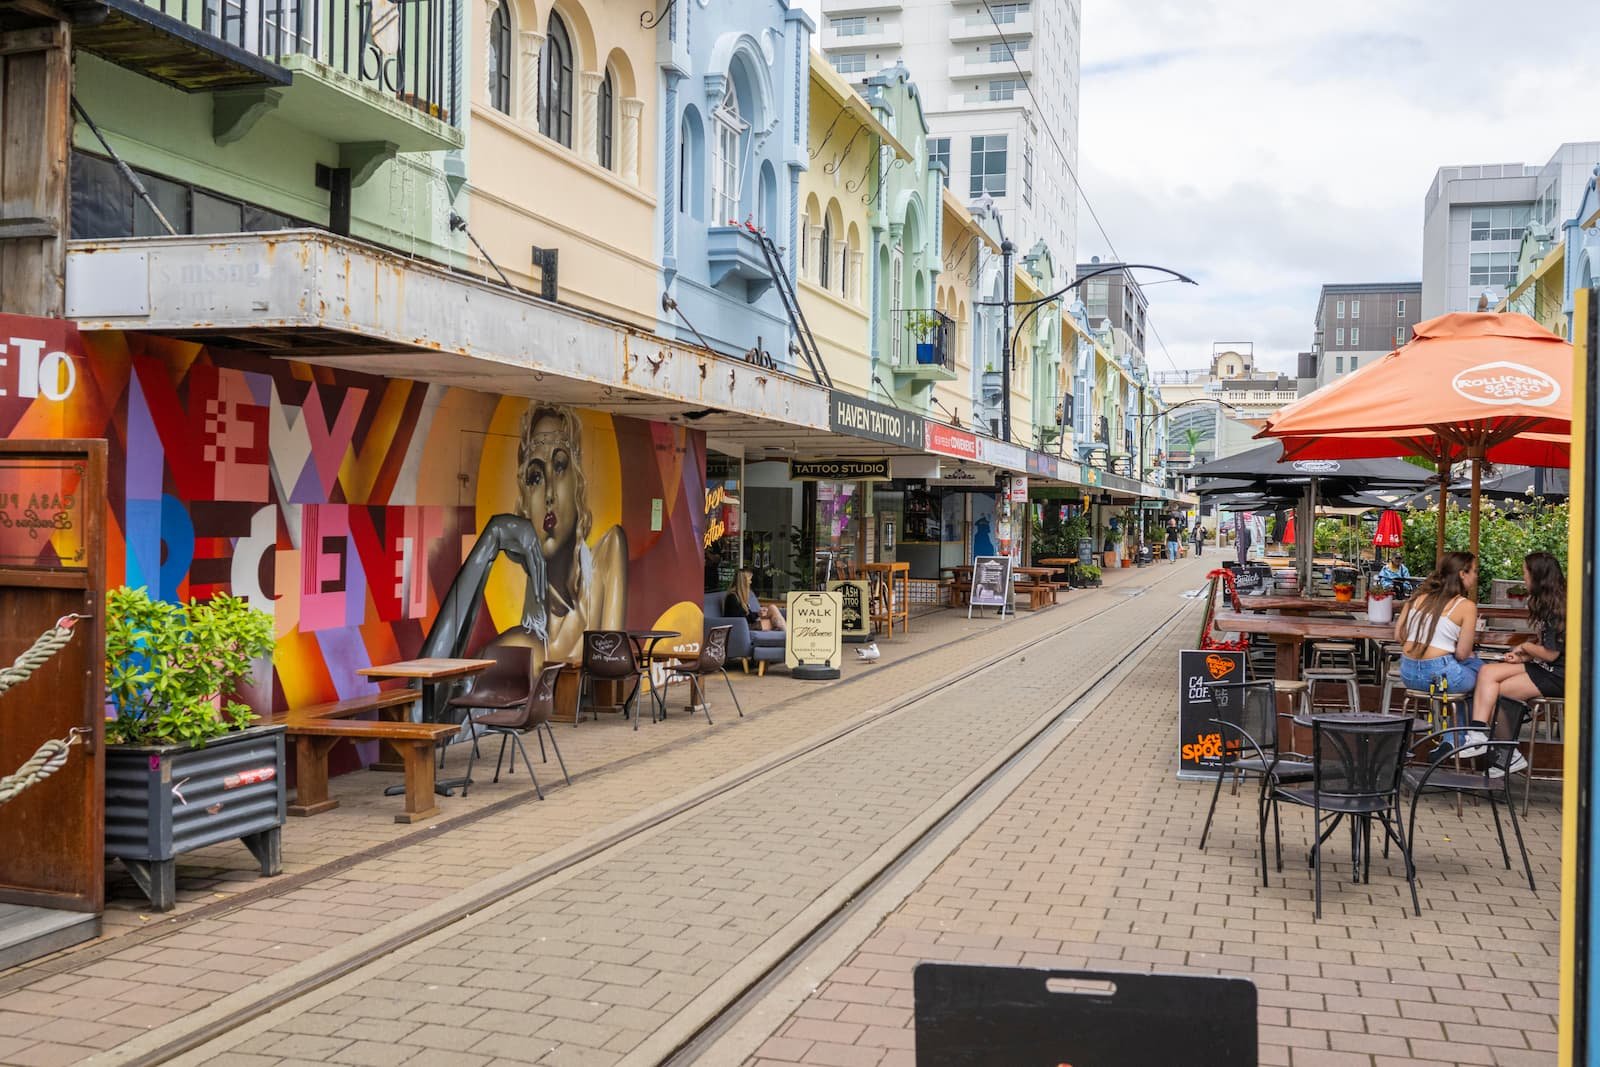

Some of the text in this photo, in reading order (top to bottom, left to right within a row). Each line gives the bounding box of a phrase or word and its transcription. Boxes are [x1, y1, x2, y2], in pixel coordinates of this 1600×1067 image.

[837, 401, 901, 438] HAVEN TATTOO
[795, 464, 885, 473] TATTOO STUDIO
[704, 486, 725, 514] ven
[703, 518, 725, 550] attoo
[840, 585, 859, 597] LASH
[842, 598, 860, 608] TTOO
[798, 609, 832, 617] WALK
[793, 626, 832, 638] Welcome
[1189, 676, 1204, 688] C4
